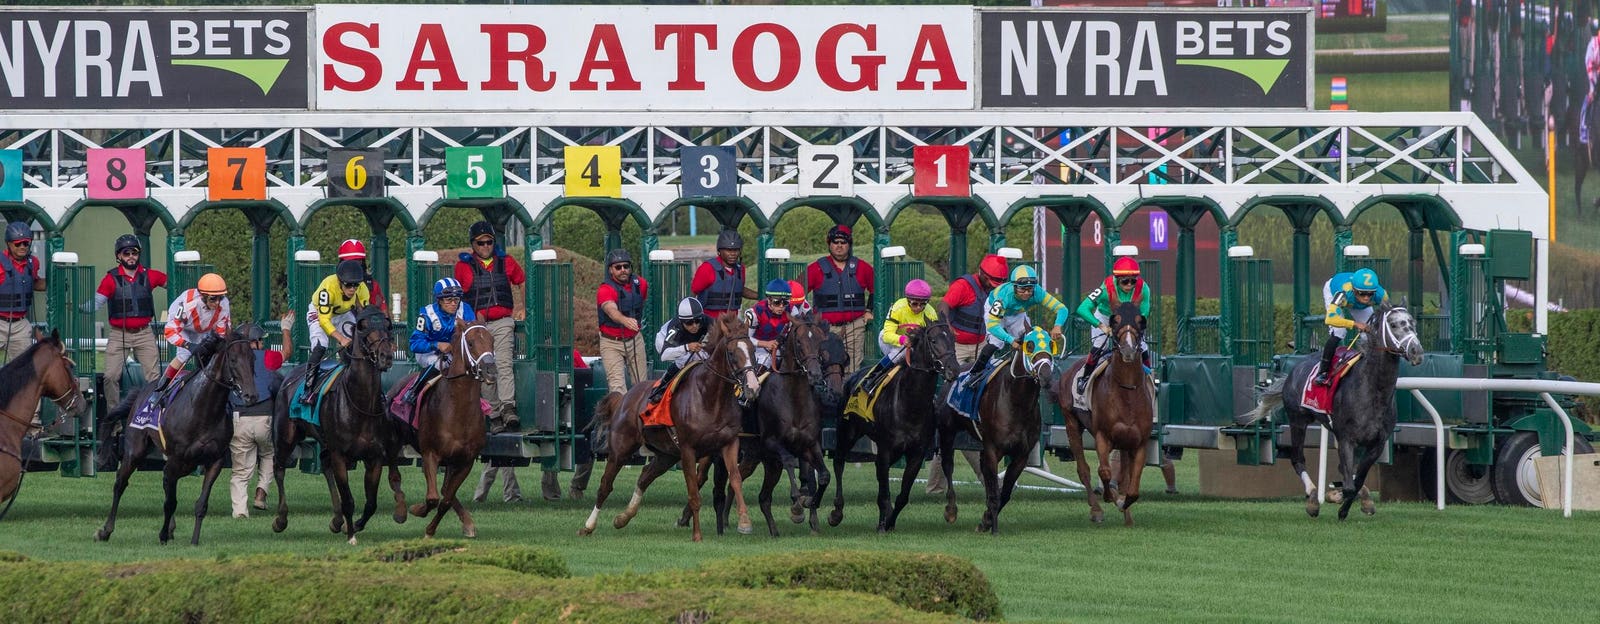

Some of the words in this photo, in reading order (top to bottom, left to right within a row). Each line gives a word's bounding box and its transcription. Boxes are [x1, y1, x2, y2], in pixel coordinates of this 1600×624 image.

[0, 20, 163, 97] NYRA
[171, 20, 291, 56] BETS
[323, 23, 967, 92] SARATOGA
[1000, 20, 1167, 96] NYRA
[1175, 20, 1292, 56] BETS
[106, 157, 127, 191] 8
[227, 157, 247, 191] 7
[345, 156, 367, 191] 6
[466, 154, 487, 189] 5
[581, 154, 602, 188] 4
[699, 154, 720, 189] 3
[812, 154, 839, 189] 2
[933, 154, 949, 188] 1
[1094, 220, 1102, 245] 8
[1153, 218, 1165, 243] 10
[1088, 288, 1102, 300] 2
[1363, 273, 1373, 286] Z
[319, 290, 328, 306] 9
[990, 301, 1001, 316] 3
[416, 316, 425, 331] 8
[665, 329, 676, 342] 7
